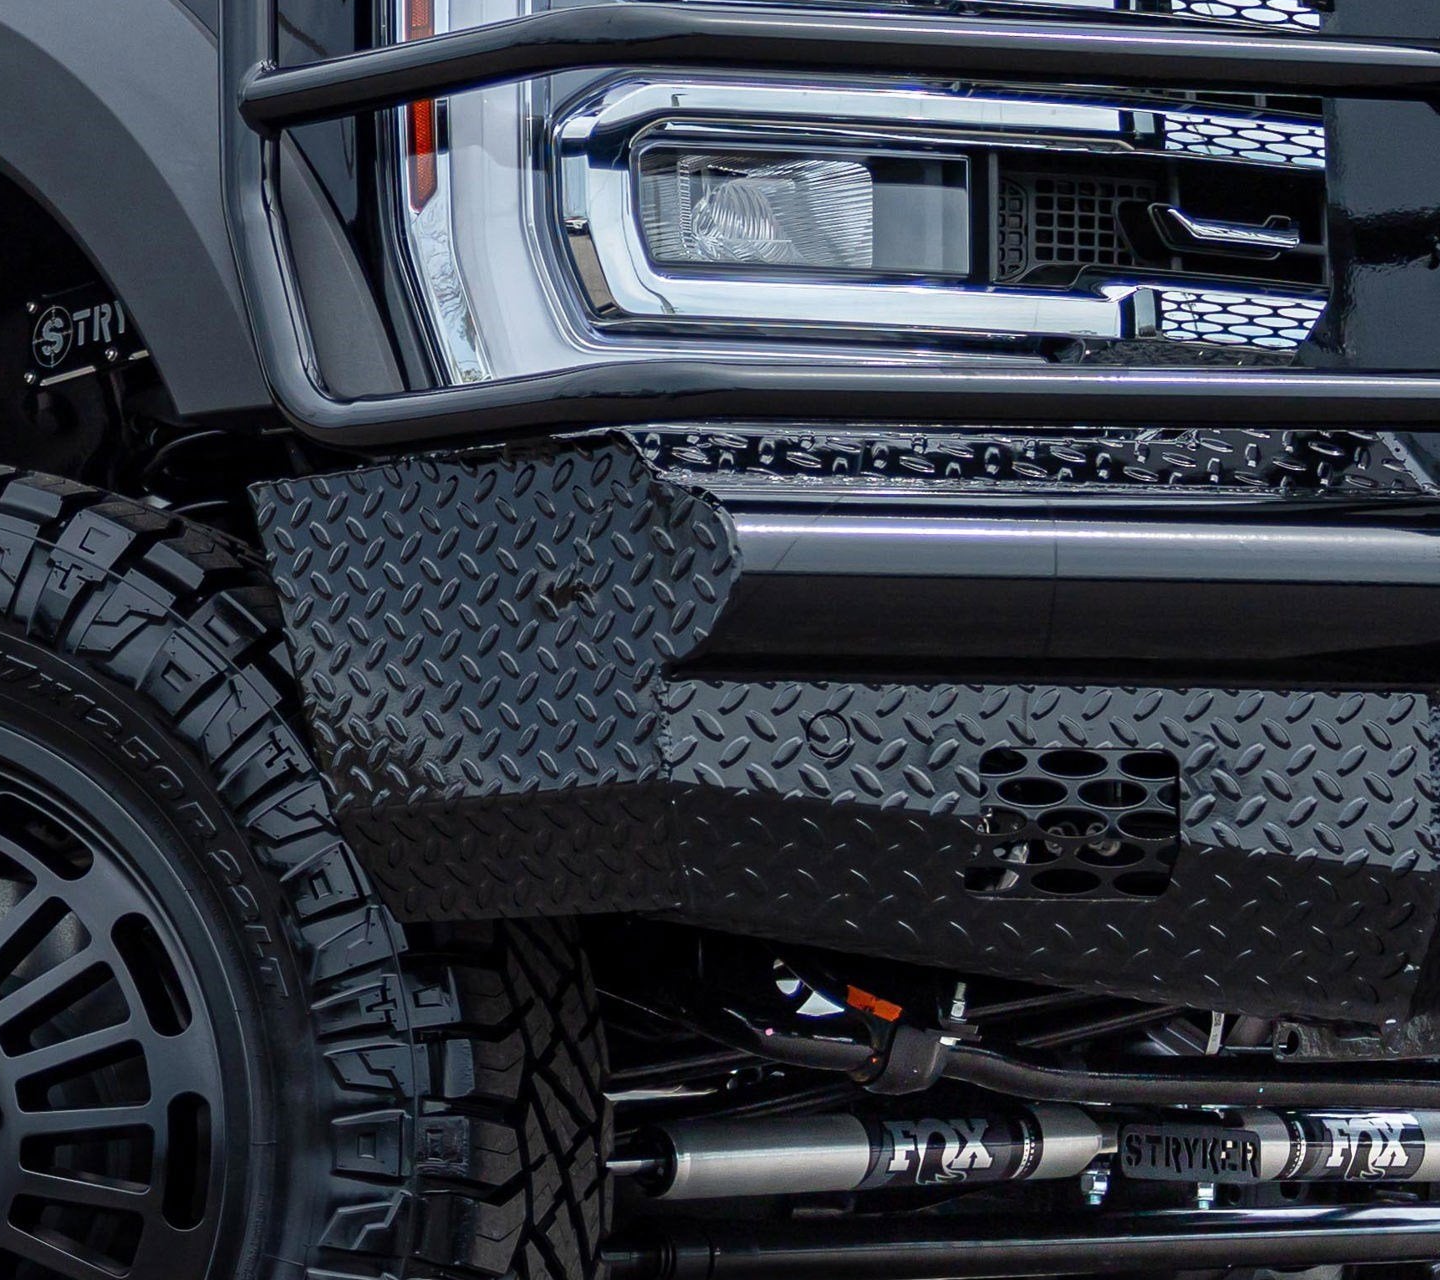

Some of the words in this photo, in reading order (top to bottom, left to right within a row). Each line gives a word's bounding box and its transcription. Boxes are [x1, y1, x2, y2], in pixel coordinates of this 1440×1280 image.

[884, 1119, 994, 1184] FOX
[1125, 1132, 1258, 1178] STRYKER
[1324, 1114, 1417, 1181] FOX
